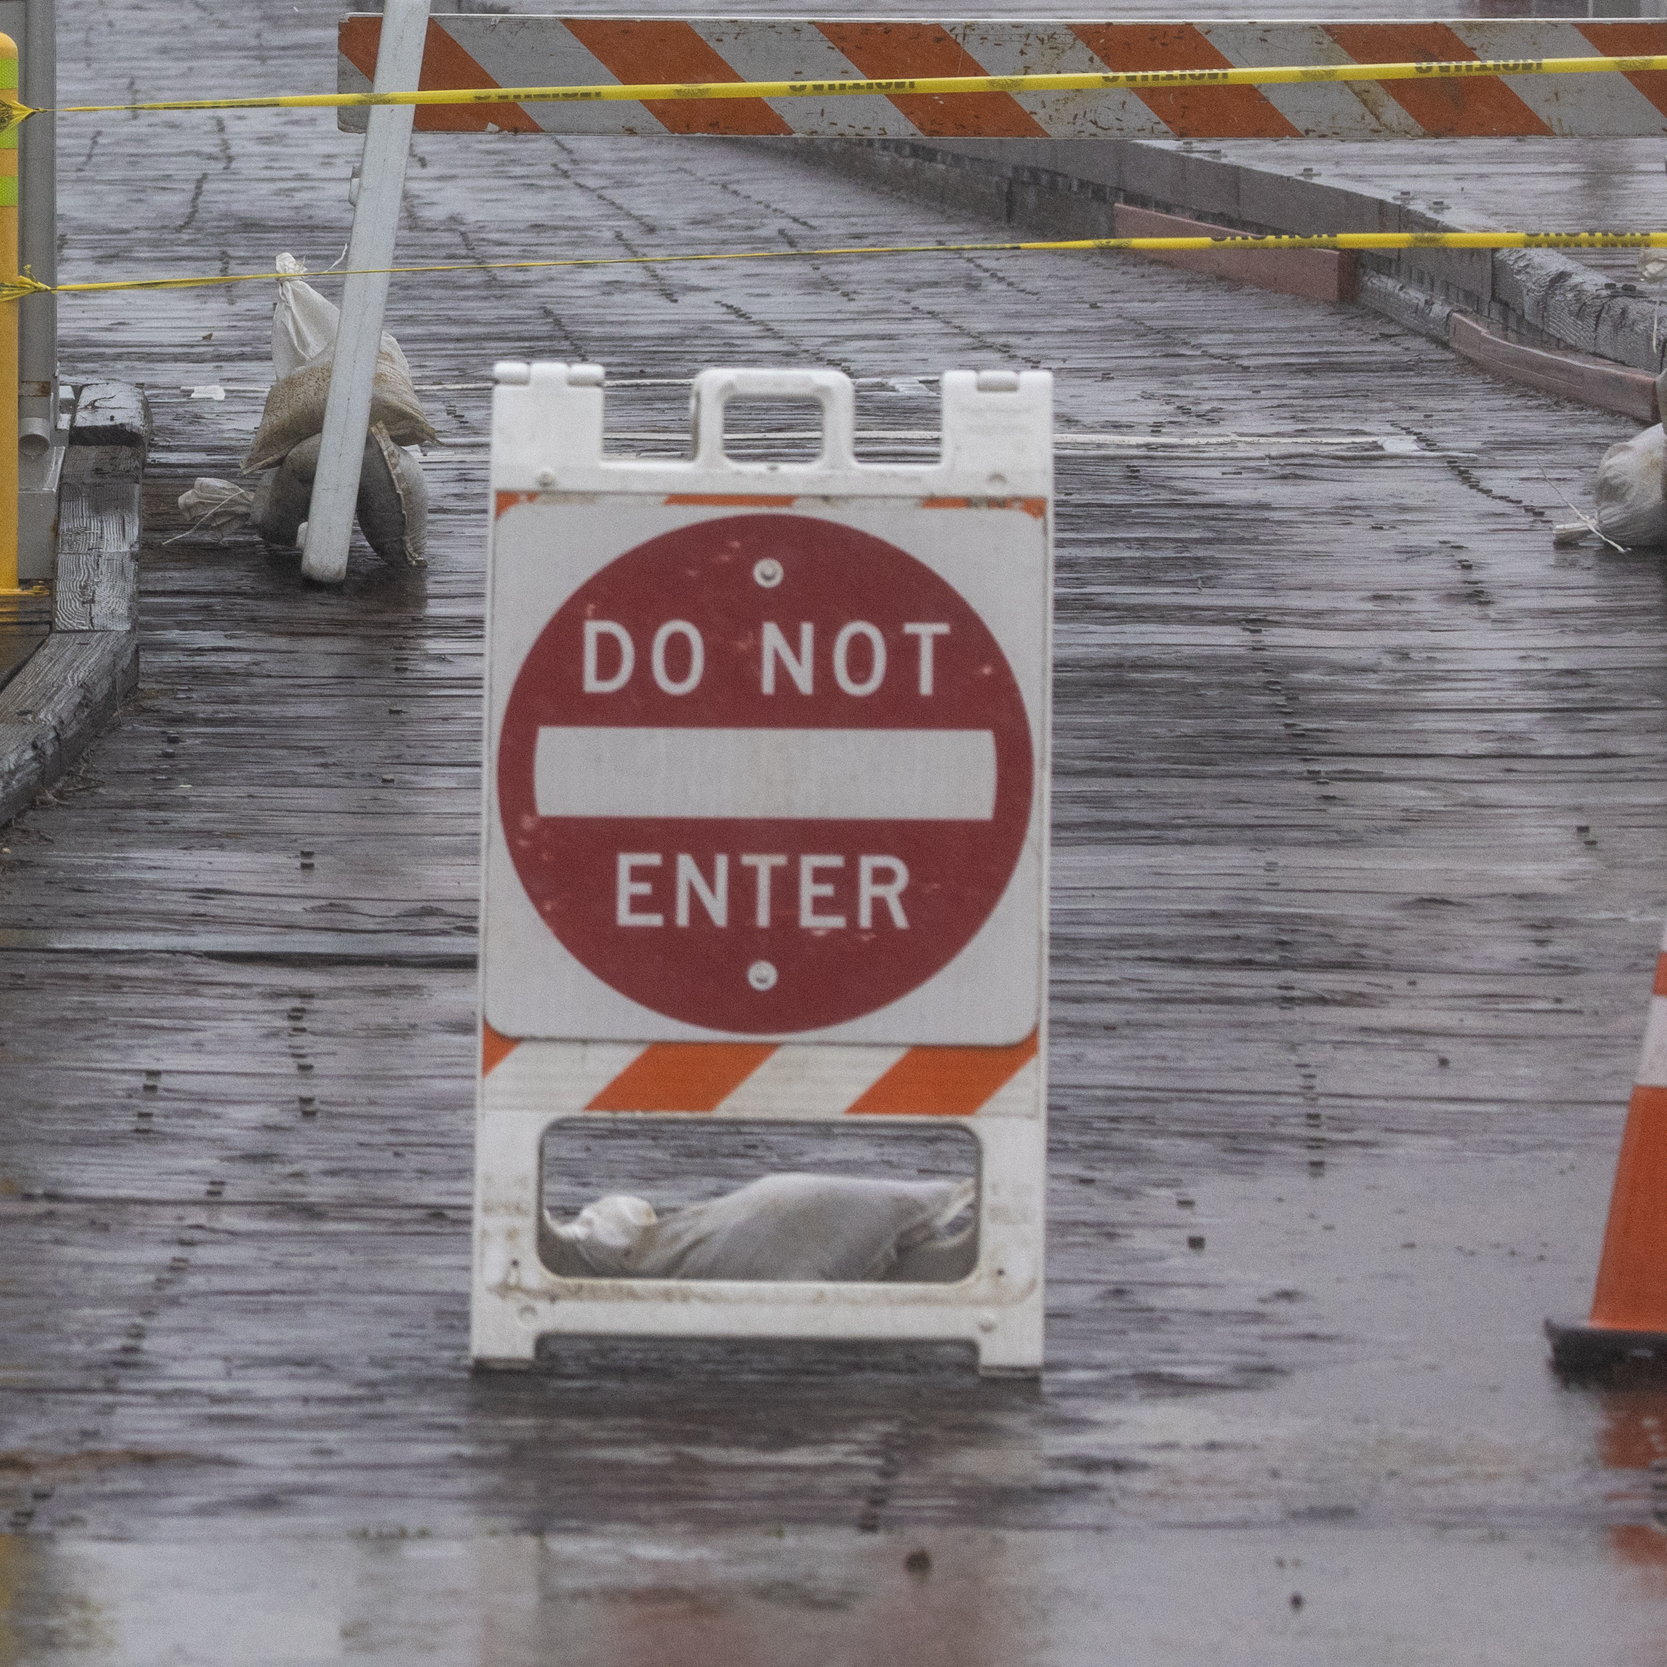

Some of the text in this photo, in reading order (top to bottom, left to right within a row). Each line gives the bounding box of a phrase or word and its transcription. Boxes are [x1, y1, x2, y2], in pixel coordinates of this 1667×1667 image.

[583, 619, 951, 697] DO NOT
[616, 852, 910, 931] ENTER
